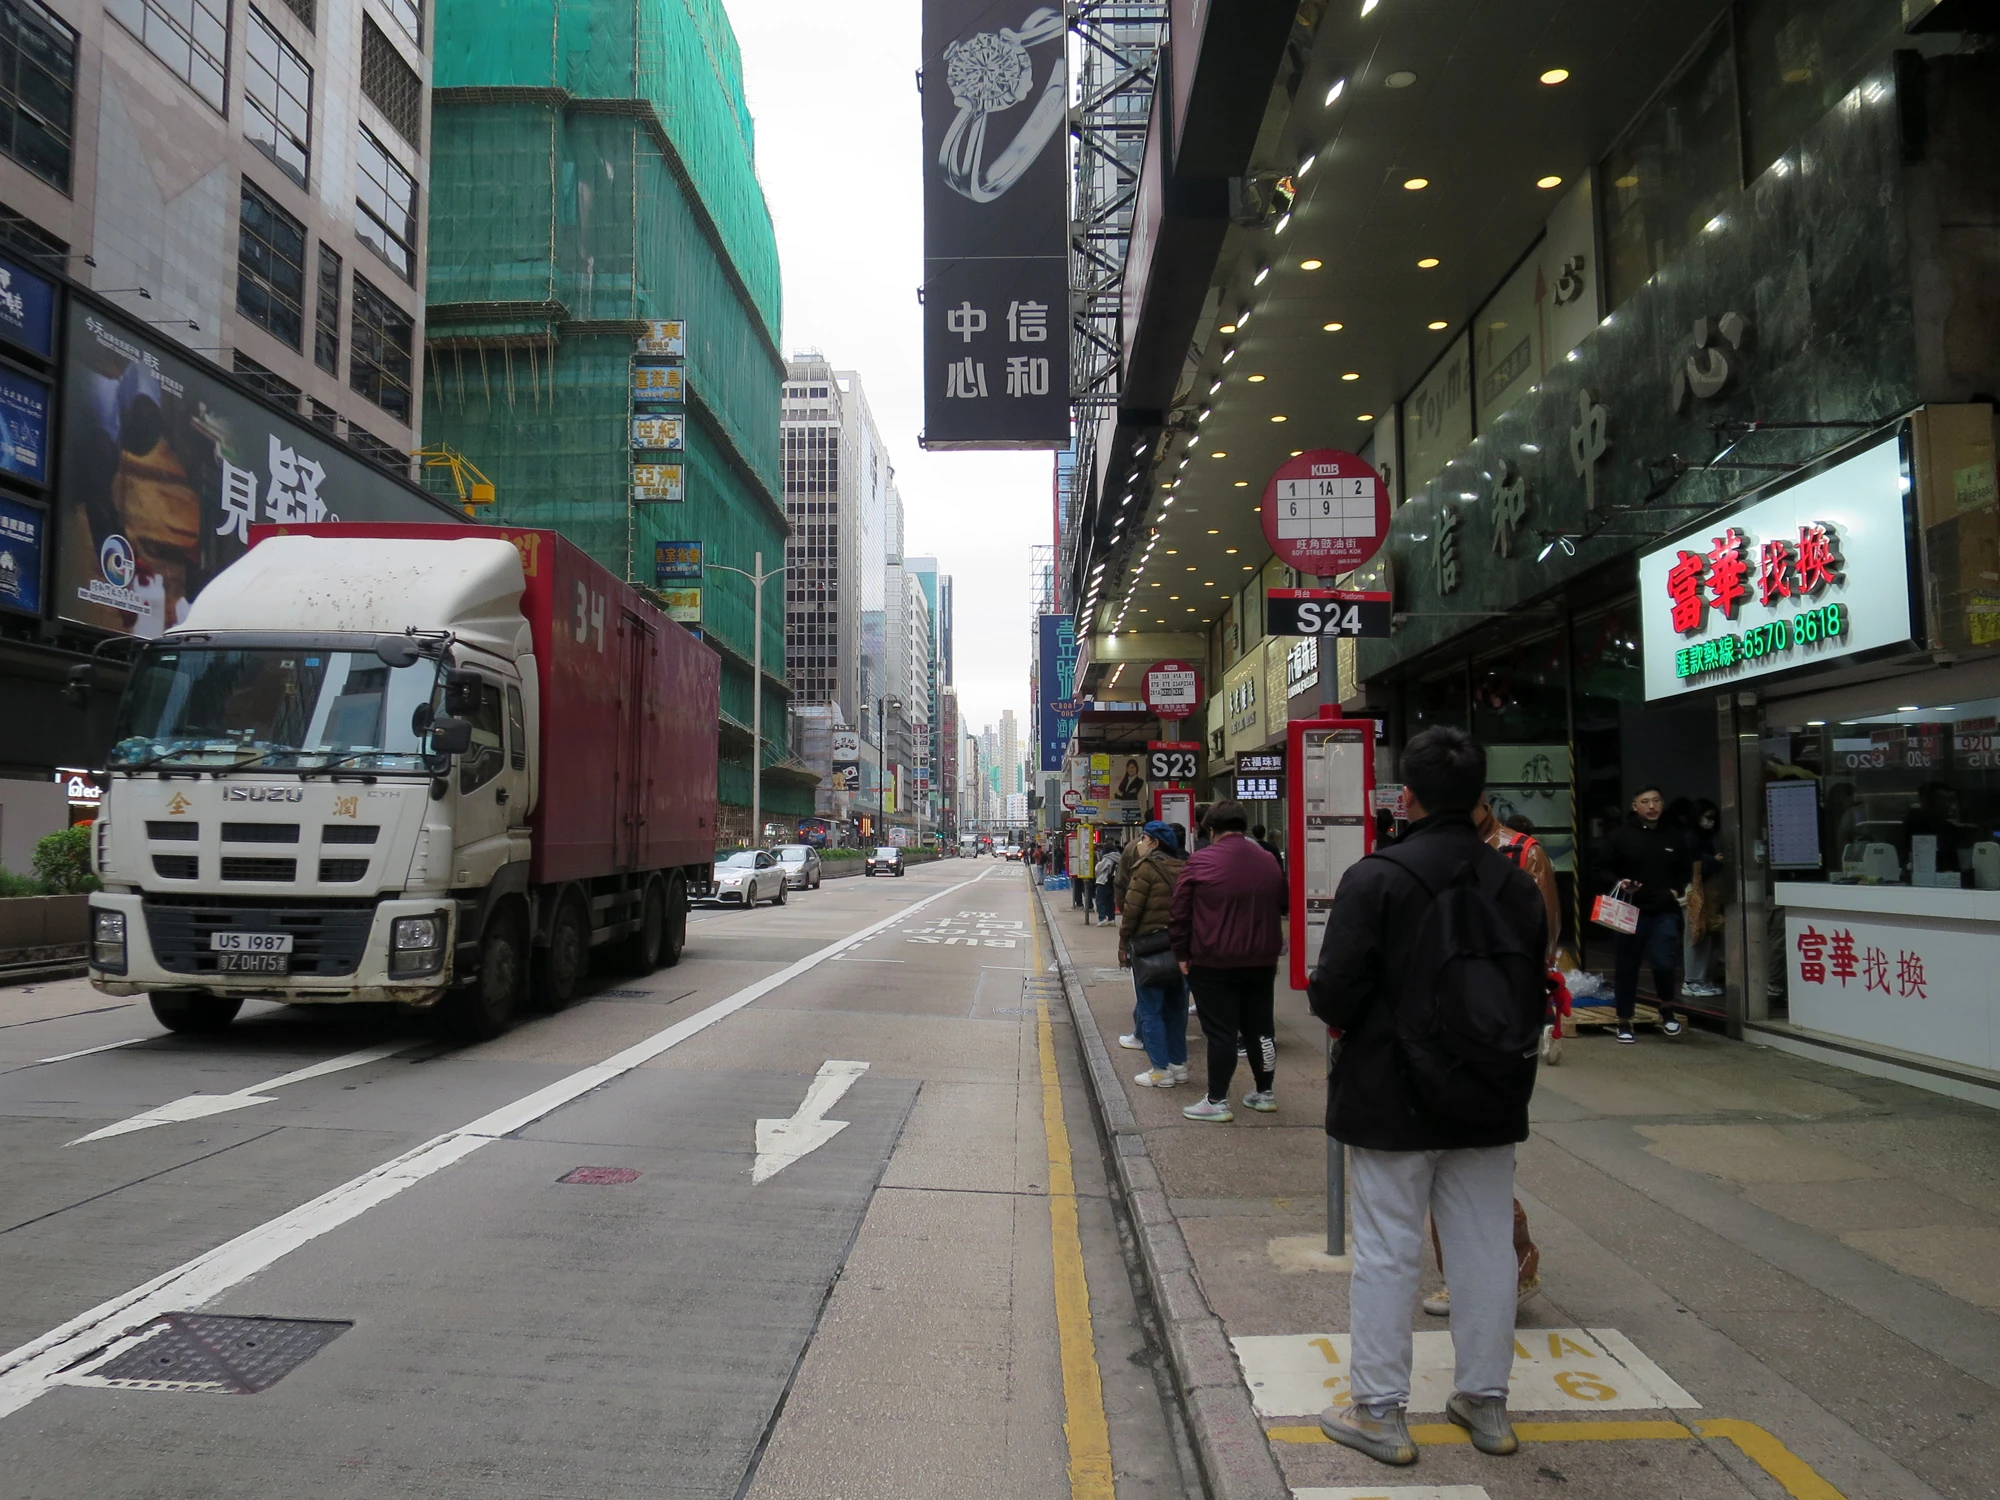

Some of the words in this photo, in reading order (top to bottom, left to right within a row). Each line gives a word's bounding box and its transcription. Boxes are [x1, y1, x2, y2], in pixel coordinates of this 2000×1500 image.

[637, 421, 676, 438] 世紀
[1433, 311, 1751, 595] 信和中心
[634, 464, 679, 487] 亞洲
[1289, 482, 1296, 496] 1
[1319, 481, 1334, 496] 1A
[1355, 480, 1362, 494] 2
[1290, 502, 1297, 516] 6
[1323, 501, 1330, 515] 9
[1667, 523, 1836, 634] 富華找換
[1294, 590, 1310, 599] 月台
[575, 580, 604, 654] 34
[1297, 602, 1362, 634] S24
[1793, 603, 1841, 645] 8618
[1152, 753, 1196, 777] S23
[222, 786, 303, 802] ISUZU
[219, 935, 241, 948] US
[248, 936, 286, 950] 1987
[1797, 925, 1929, 1001] 富華找換
[1260, 1034, 1275, 1073] JORDAN
[1553, 1370, 1619, 1402] 6
